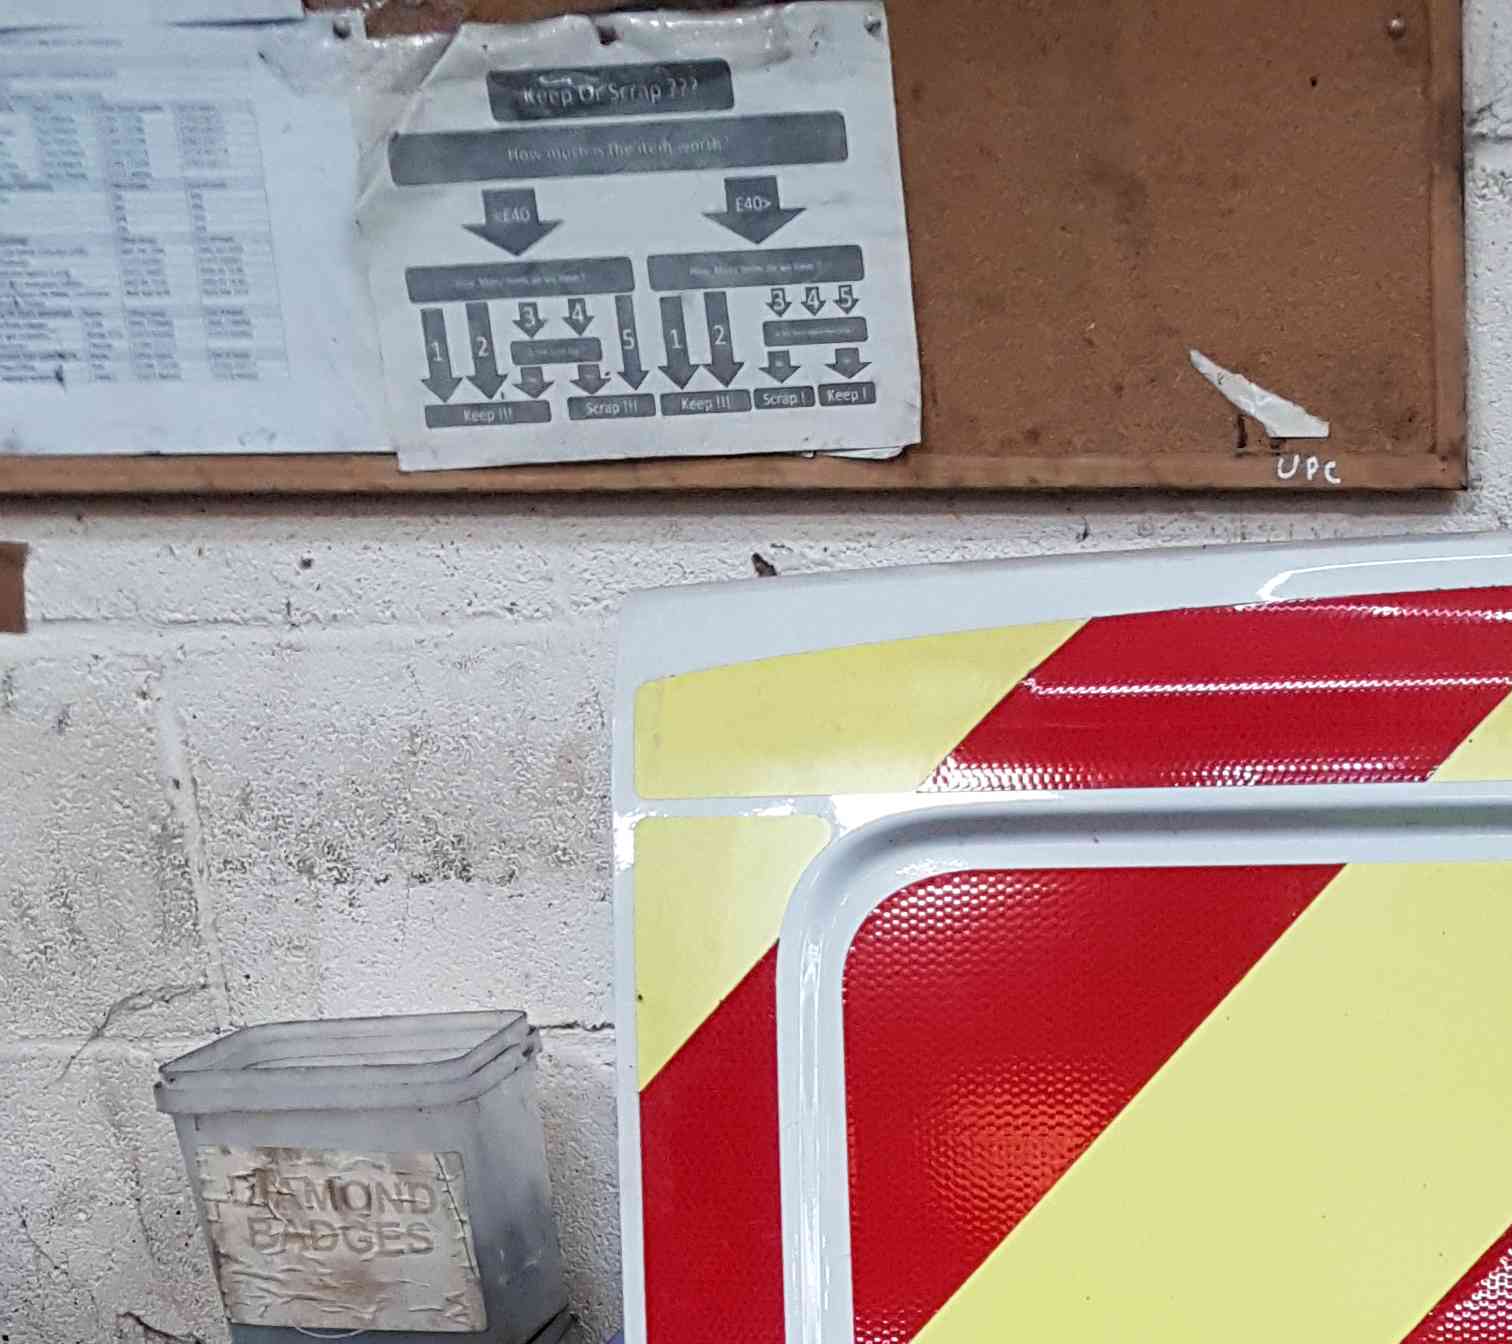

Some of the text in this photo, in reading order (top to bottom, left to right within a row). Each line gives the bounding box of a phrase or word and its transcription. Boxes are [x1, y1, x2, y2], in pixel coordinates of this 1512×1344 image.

[774, 290, 786, 312] 3
[807, 288, 819, 310] 4
[840, 286, 852, 308] 5
[523, 306, 536, 328] 3
[571, 303, 585, 324] 4
[622, 330, 635, 350] 5
[670, 328, 682, 350] 1
[712, 325, 728, 346] 2
[429, 341, 443, 362] 1
[475, 337, 490, 358] 2
[681, 398, 713, 413] Keep
[762, 393, 799, 408] Scrap
[826, 389, 860, 405] Keep
[463, 409, 495, 425] Keep
[586, 403, 621, 417] Scrap
[248, 1216, 434, 1255] BADGES
